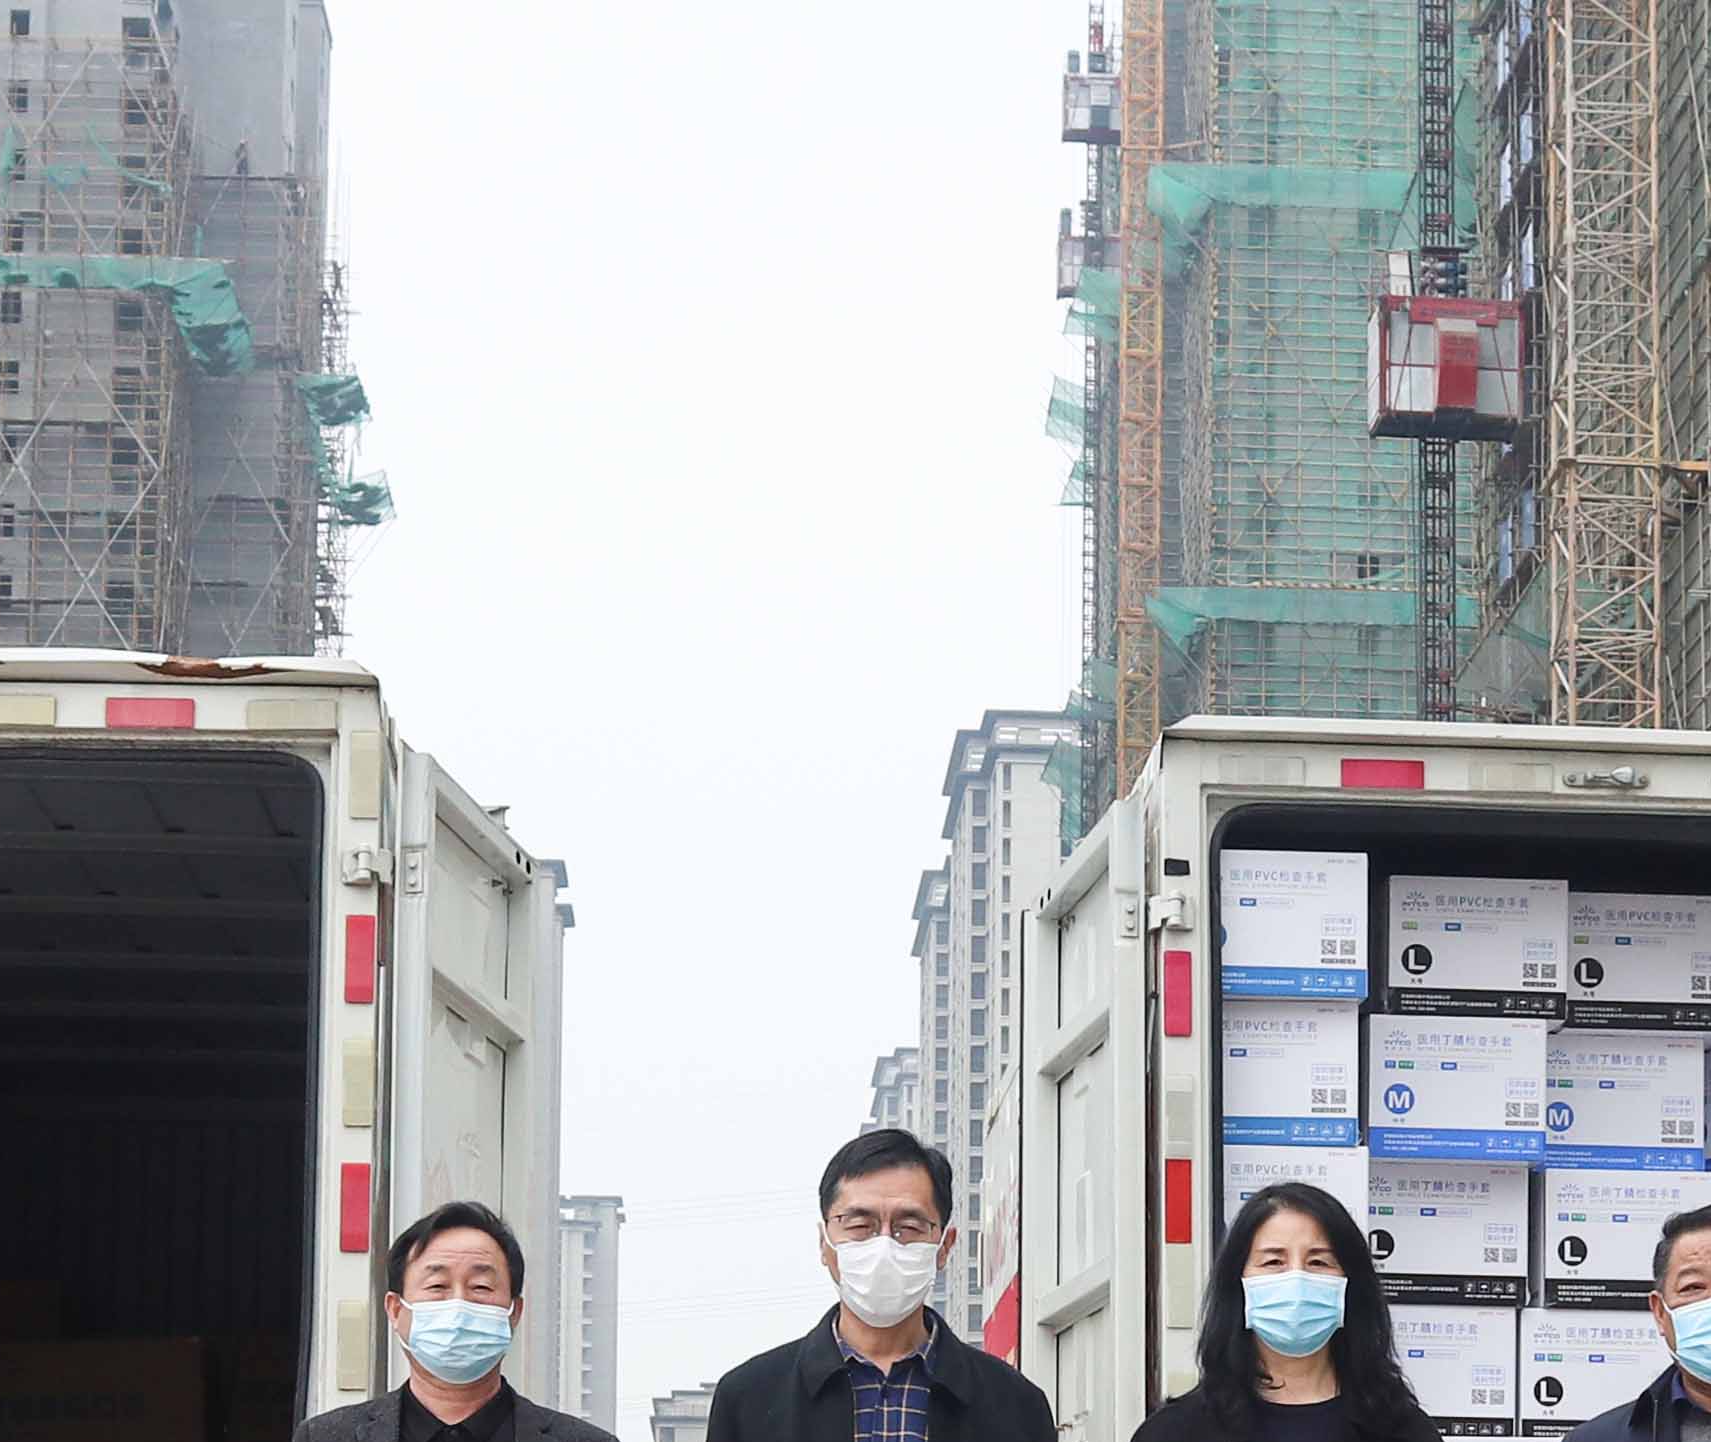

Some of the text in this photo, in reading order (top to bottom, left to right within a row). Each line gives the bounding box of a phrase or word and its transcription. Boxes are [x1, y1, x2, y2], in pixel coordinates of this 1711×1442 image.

[1408, 949, 1427, 970] L
[1580, 962, 1598, 984] L
[1388, 1090, 1410, 1109] M
[1548, 1108, 1569, 1127] M
[1371, 1233, 1388, 1256] L
[1564, 1240, 1582, 1262] L
[1540, 1381, 1558, 1402] L
